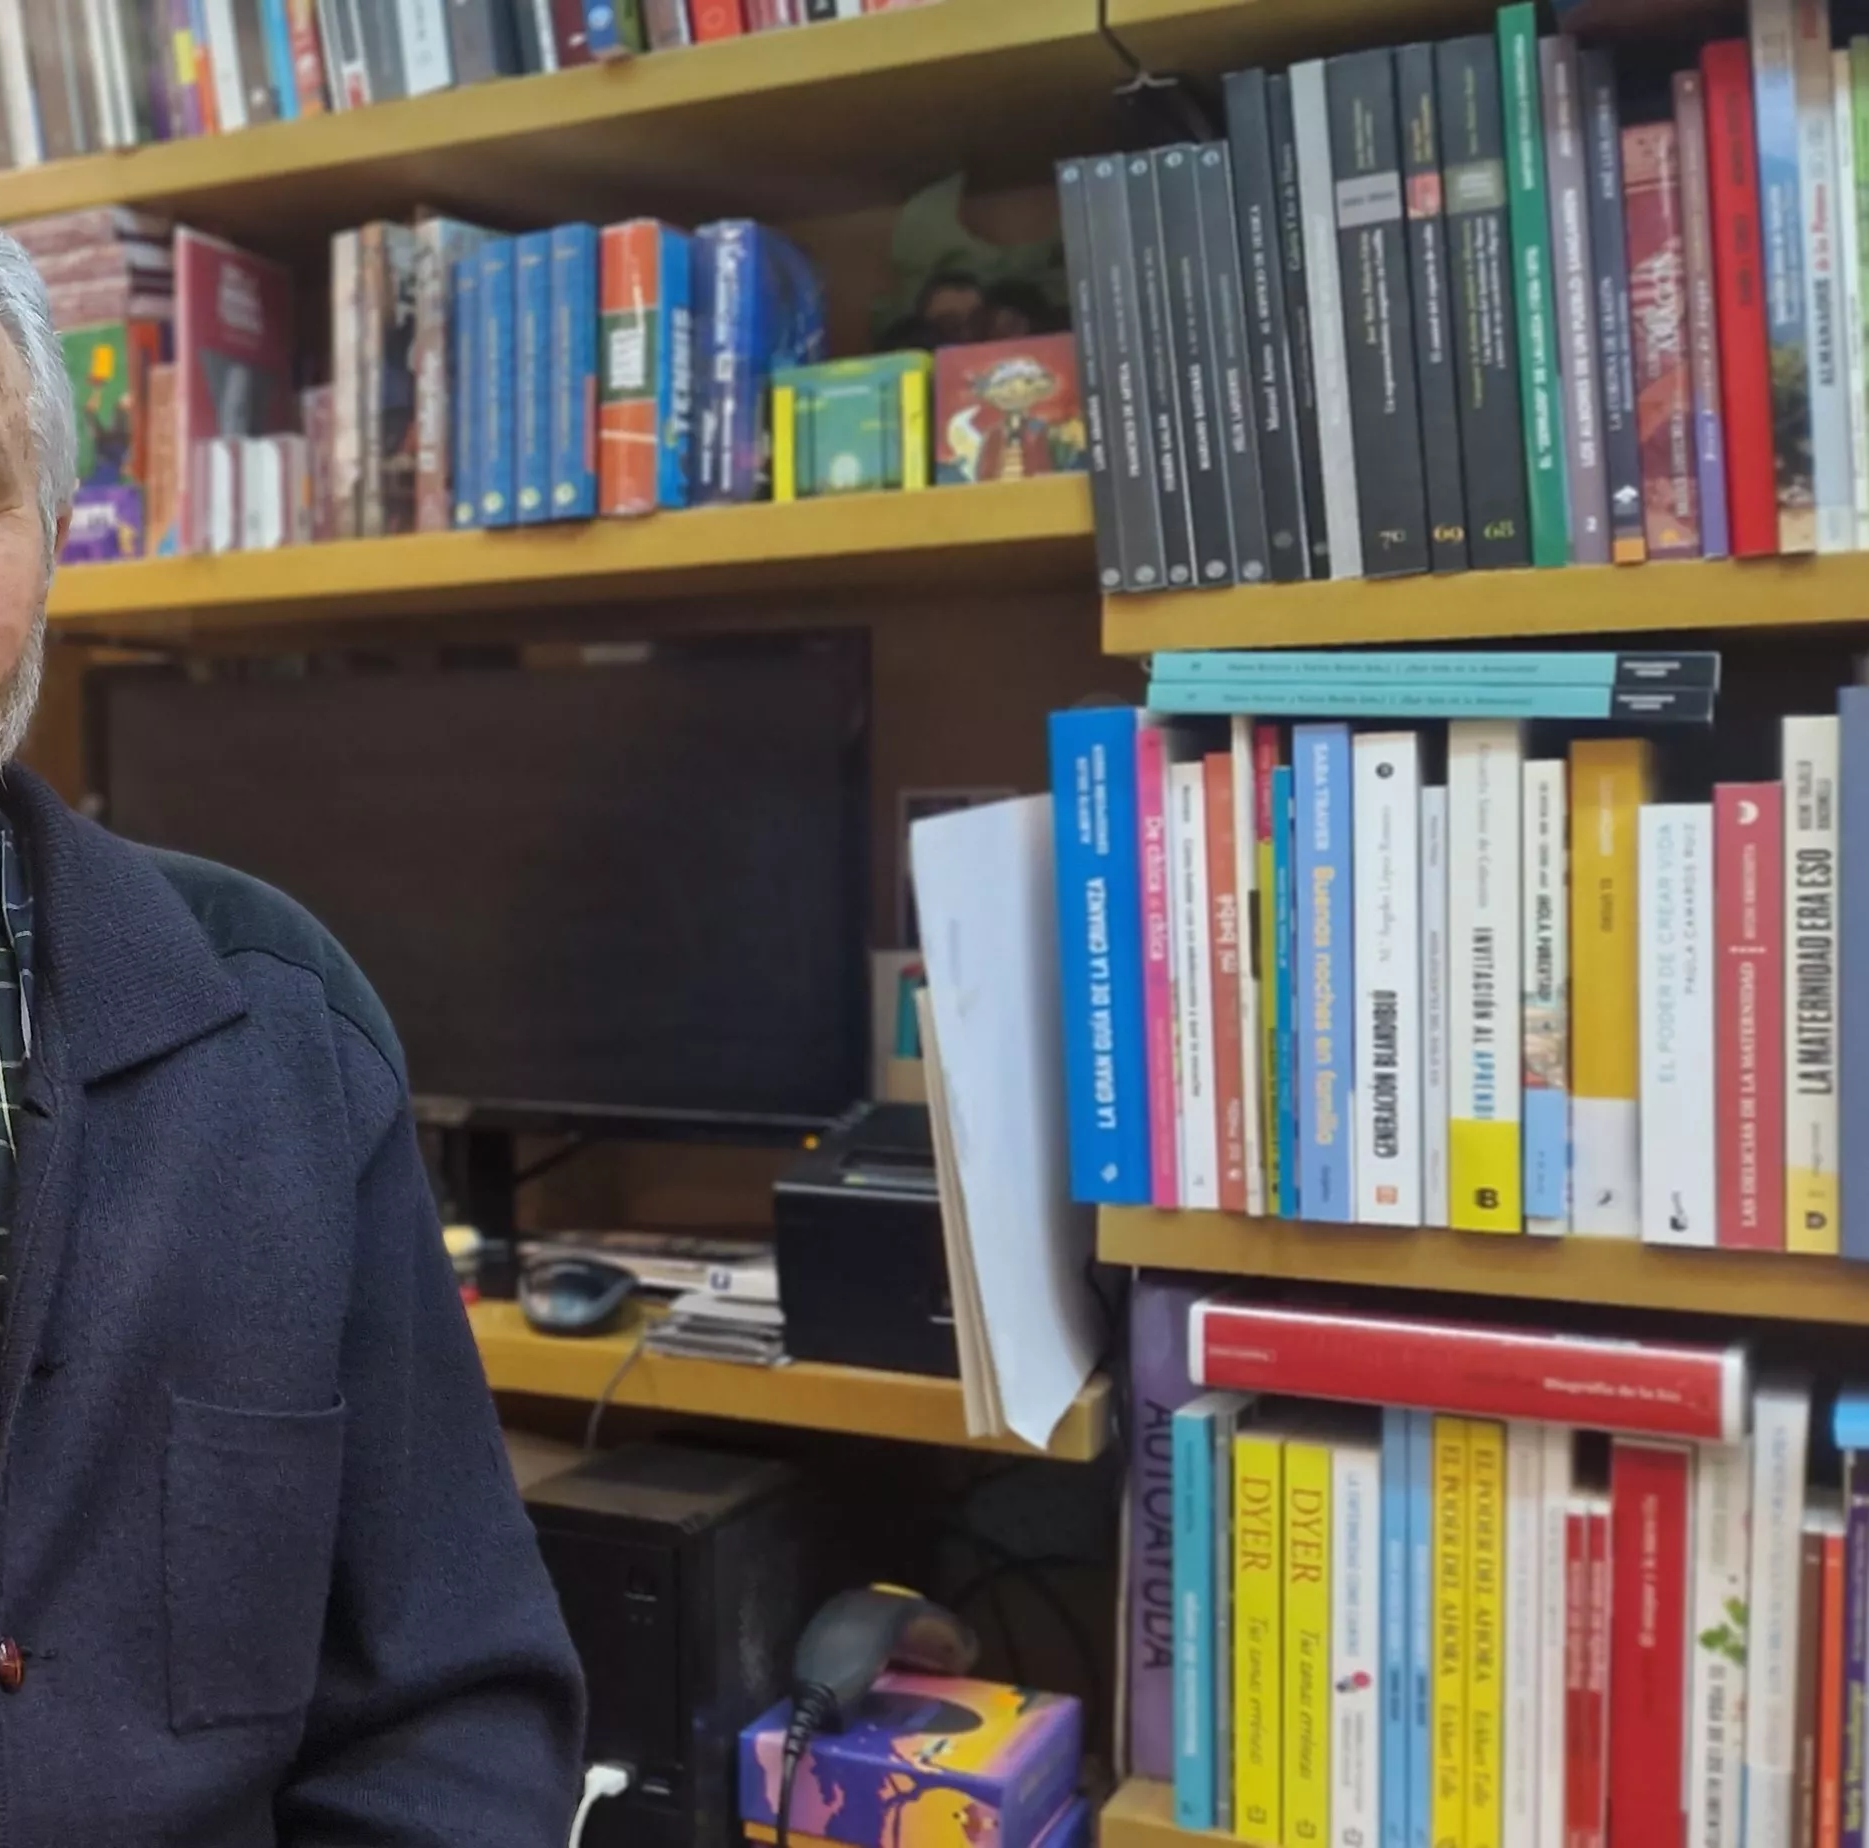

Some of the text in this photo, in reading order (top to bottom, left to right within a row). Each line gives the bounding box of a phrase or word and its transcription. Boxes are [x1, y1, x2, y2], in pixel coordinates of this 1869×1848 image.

[1378, 529, 1406, 551] 70
[1433, 525, 1465, 545] 69
[1483, 518, 1515, 541] 68
[1146, 816, 1164, 840] De
[1312, 742, 1329, 850] SARA TRAVER
[1147, 845, 1165, 892] chica
[1148, 913, 1167, 960] chica
[1220, 951, 1237, 973] mi
[1656, 823, 1676, 1083] EL PODER DE CREAR VIDA
[1682, 946, 1698, 995] PAULA
[1795, 850, 1832, 1095] LA MATERNIDAD ERA ESO
[1086, 878, 1117, 1128] LA GRAN GUÍA DE LA CRIANZA
[1312, 866, 1340, 1145] Buenas noches en familia
[1471, 929, 1497, 1047] INVITACIÓN AL
[1366, 1072, 1399, 1159] GENERACIÓN
[1739, 962, 1757, 1227] LAS DELICIAS DE LA MATERNIDAD
[1240, 1476, 1273, 1572] DYER
[1289, 1488, 1324, 1584] DYER
[1439, 1444, 1460, 1677] EL PODER DEL AHORA
[1475, 1449, 1496, 1684] EL PODER DEL AHORA
